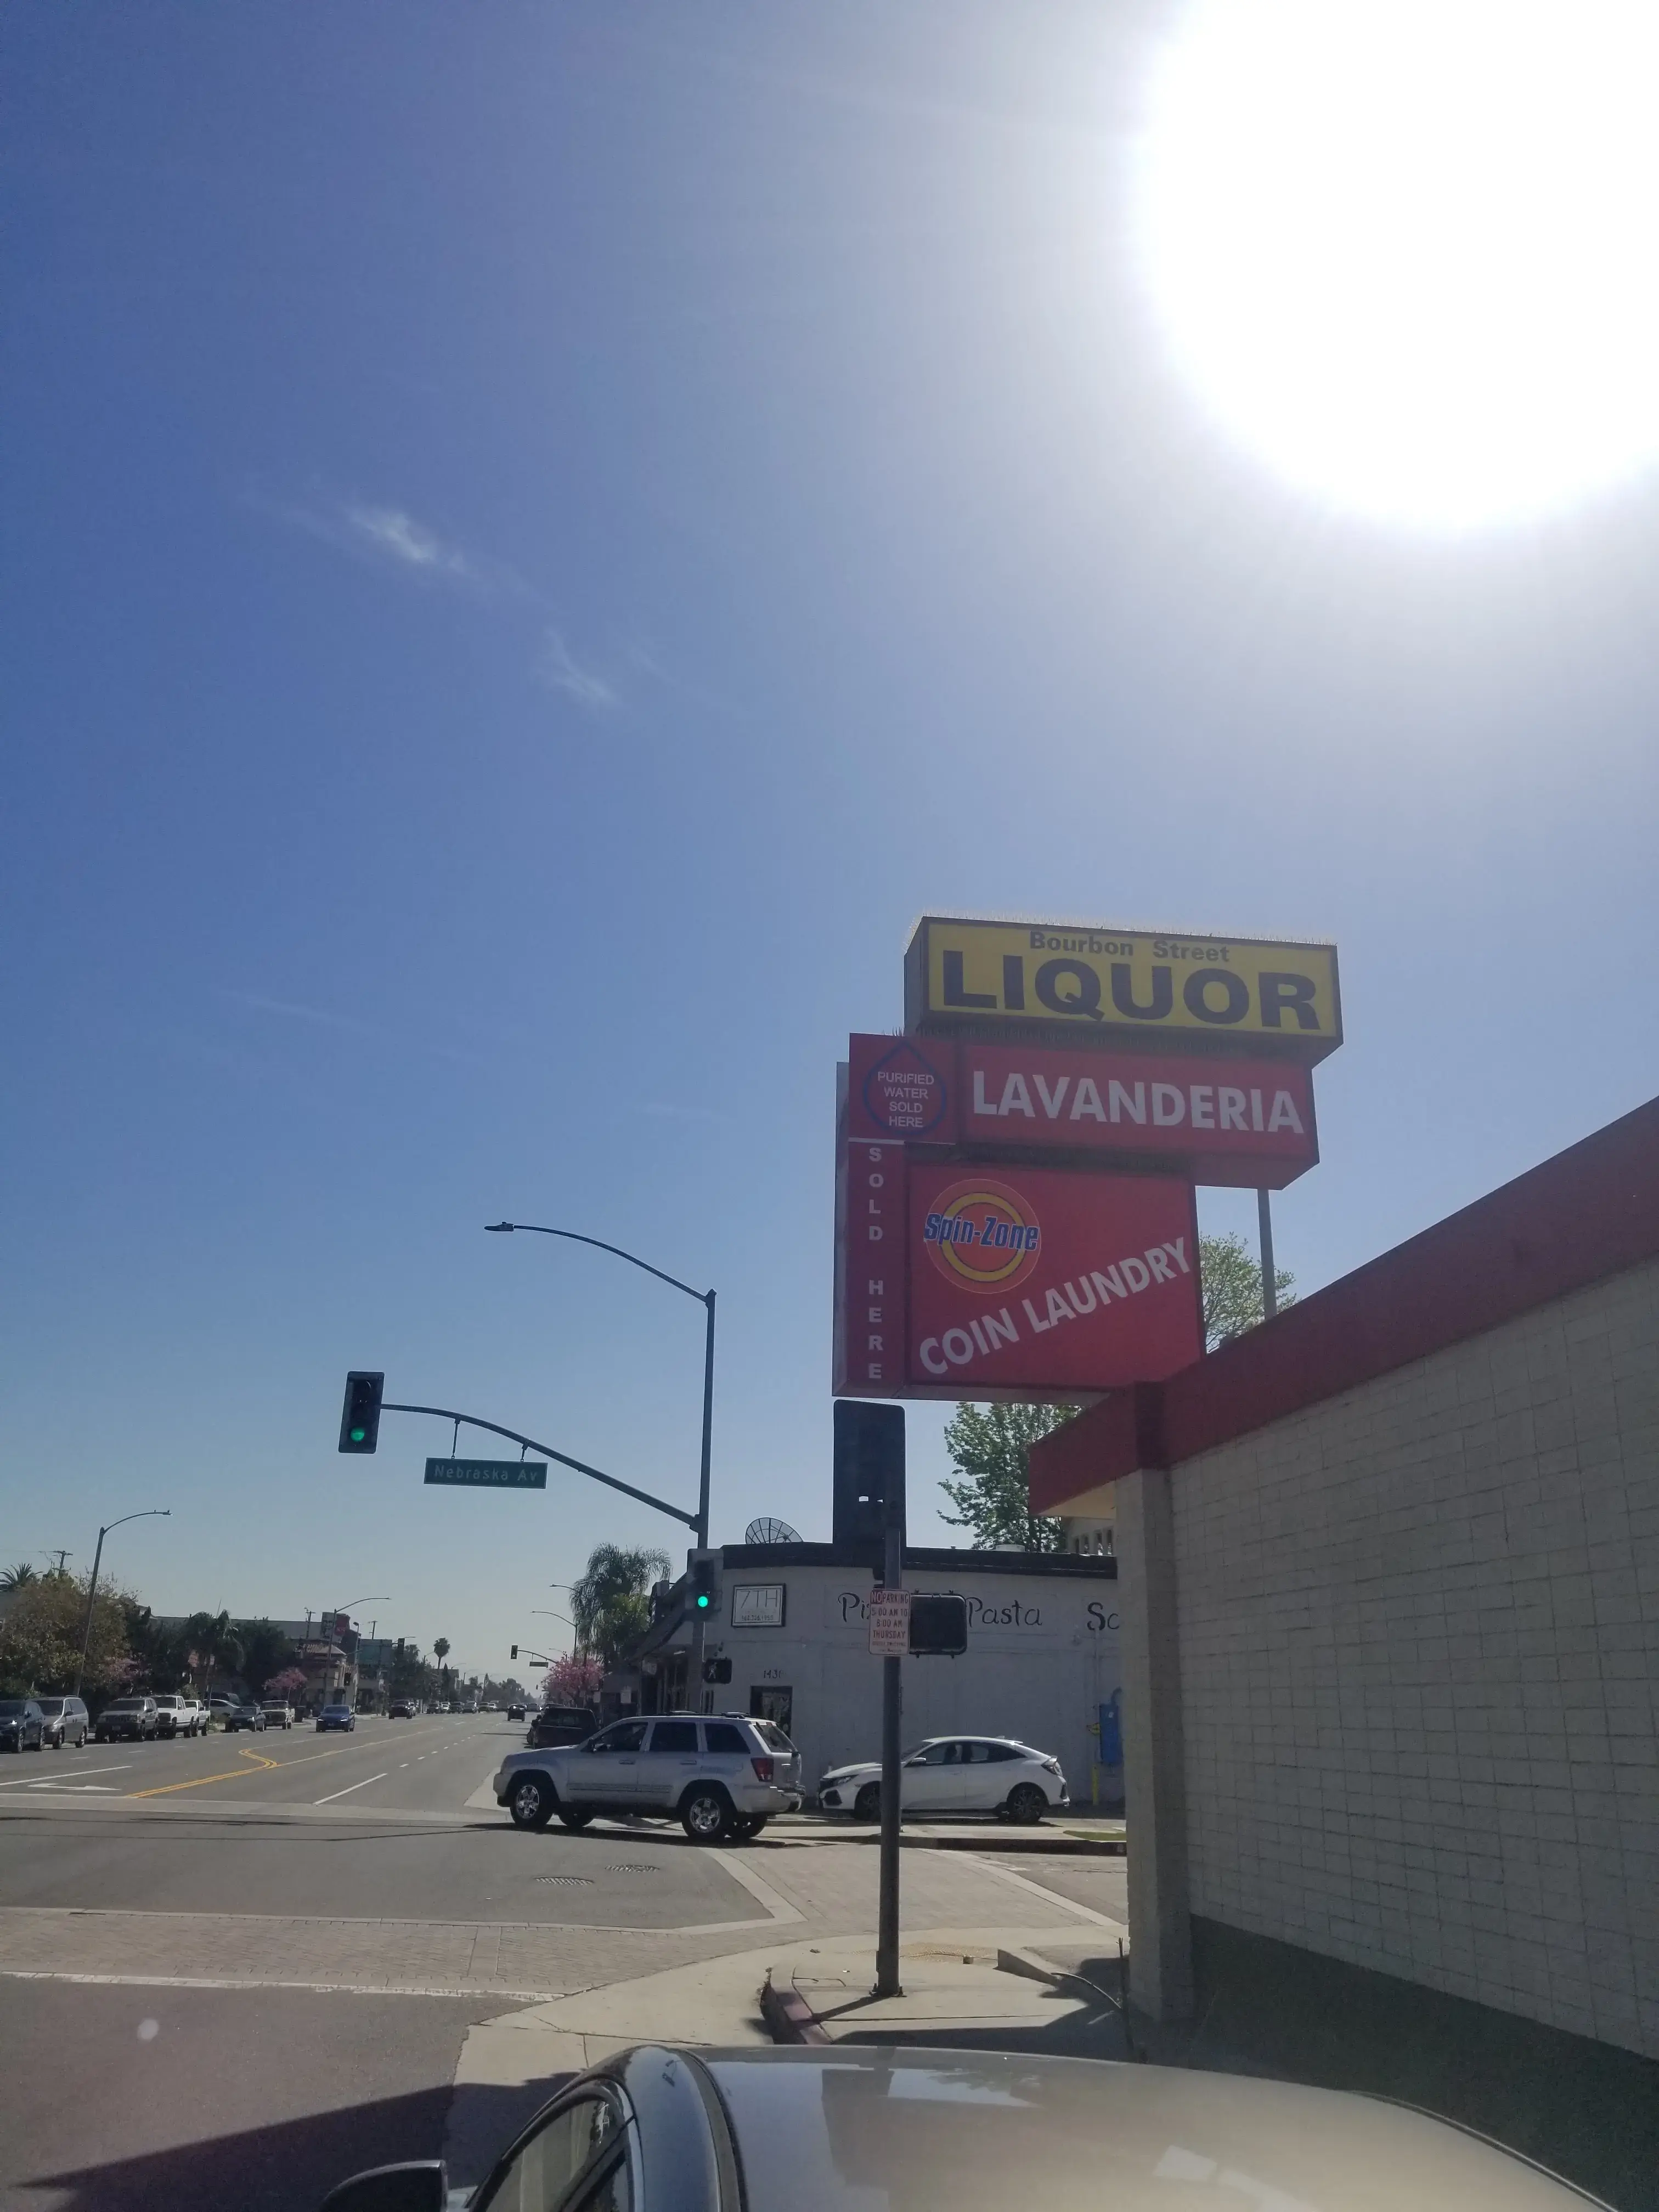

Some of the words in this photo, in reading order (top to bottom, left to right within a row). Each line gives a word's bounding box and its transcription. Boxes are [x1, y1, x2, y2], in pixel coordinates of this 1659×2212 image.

[1029, 930, 1135, 957] Bourbon
[1153, 939, 1230, 964] Street
[943, 950, 1322, 1030] LIQUOR
[878, 1071, 934, 1085] PURIFIED
[884, 1086, 928, 1099] WATER
[973, 1070, 1305, 1135] LAVANDERIA
[889, 1101, 923, 1113] SOLD
[889, 1116, 923, 1128] HERE
[868, 1147, 884, 1241] SOLD
[924, 1212, 1040, 1251] Spin-Zone
[919, 1307, 1020, 1375] COIN
[1021, 1237, 1191, 1334] LAUNDRY
[868, 1279, 884, 1380] HERE
[433, 1464, 509, 1482] Nebraska
[516, 1468, 538, 1482] Av
[740, 1589, 778, 1609] 7TH
[872, 1591, 882, 1602] NO
[882, 1593, 909, 1604] PARKING
[965, 1596, 1043, 1628] Pasta
[873, 1630, 906, 1639] THURSDAY
